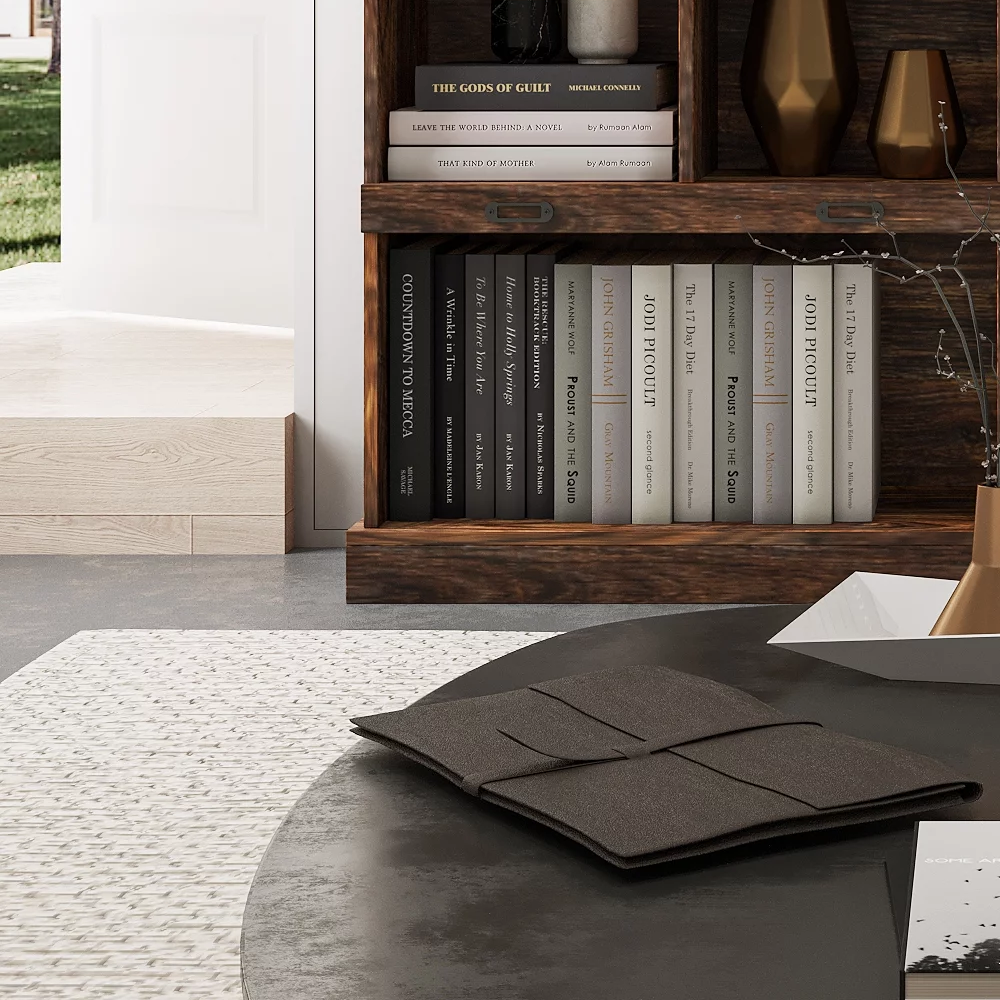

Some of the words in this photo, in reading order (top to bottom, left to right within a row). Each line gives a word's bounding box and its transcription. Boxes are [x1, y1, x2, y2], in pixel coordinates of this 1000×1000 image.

[432, 83, 457, 93] THE
[459, 83, 494, 93] GODS
[496, 83, 513, 93] OF
[515, 83, 552, 93] GUILT
[587, 124, 598, 132] by
[599, 123, 631, 131] Rumaan
[587, 160, 597, 168] by
[620, 159, 652, 167] Rumaan
[446, 287, 455, 295] A
[476, 277, 486, 290] To
[506, 276, 516, 309] Home
[686, 283, 696, 306] The
[476, 293, 486, 308] Be
[600, 277, 614, 316] JOHN
[402, 274, 413, 364] COUNTDOWN
[446, 298, 456, 339] Wrinkle
[506, 312, 514, 323] to
[644, 294, 655, 331] JODI
[686, 310, 695, 322] 17
[476, 312, 486, 348] Where
[683, 326, 696, 348] Day
[446, 343, 455, 353] in
[503, 326, 517, 359] Holly
[476, 351, 486, 370] You
[603, 321, 615, 388] GRISHAM
[686, 351, 696, 374] Diet
[402, 367, 413, 386] TO
[446, 355, 455, 382] Time
[644, 338, 656, 407] PICOULT
[476, 373, 486, 395] Are
[503, 361, 516, 406] Springs
[402, 389, 413, 438] MECCA
[644, 464, 653, 495] glance
